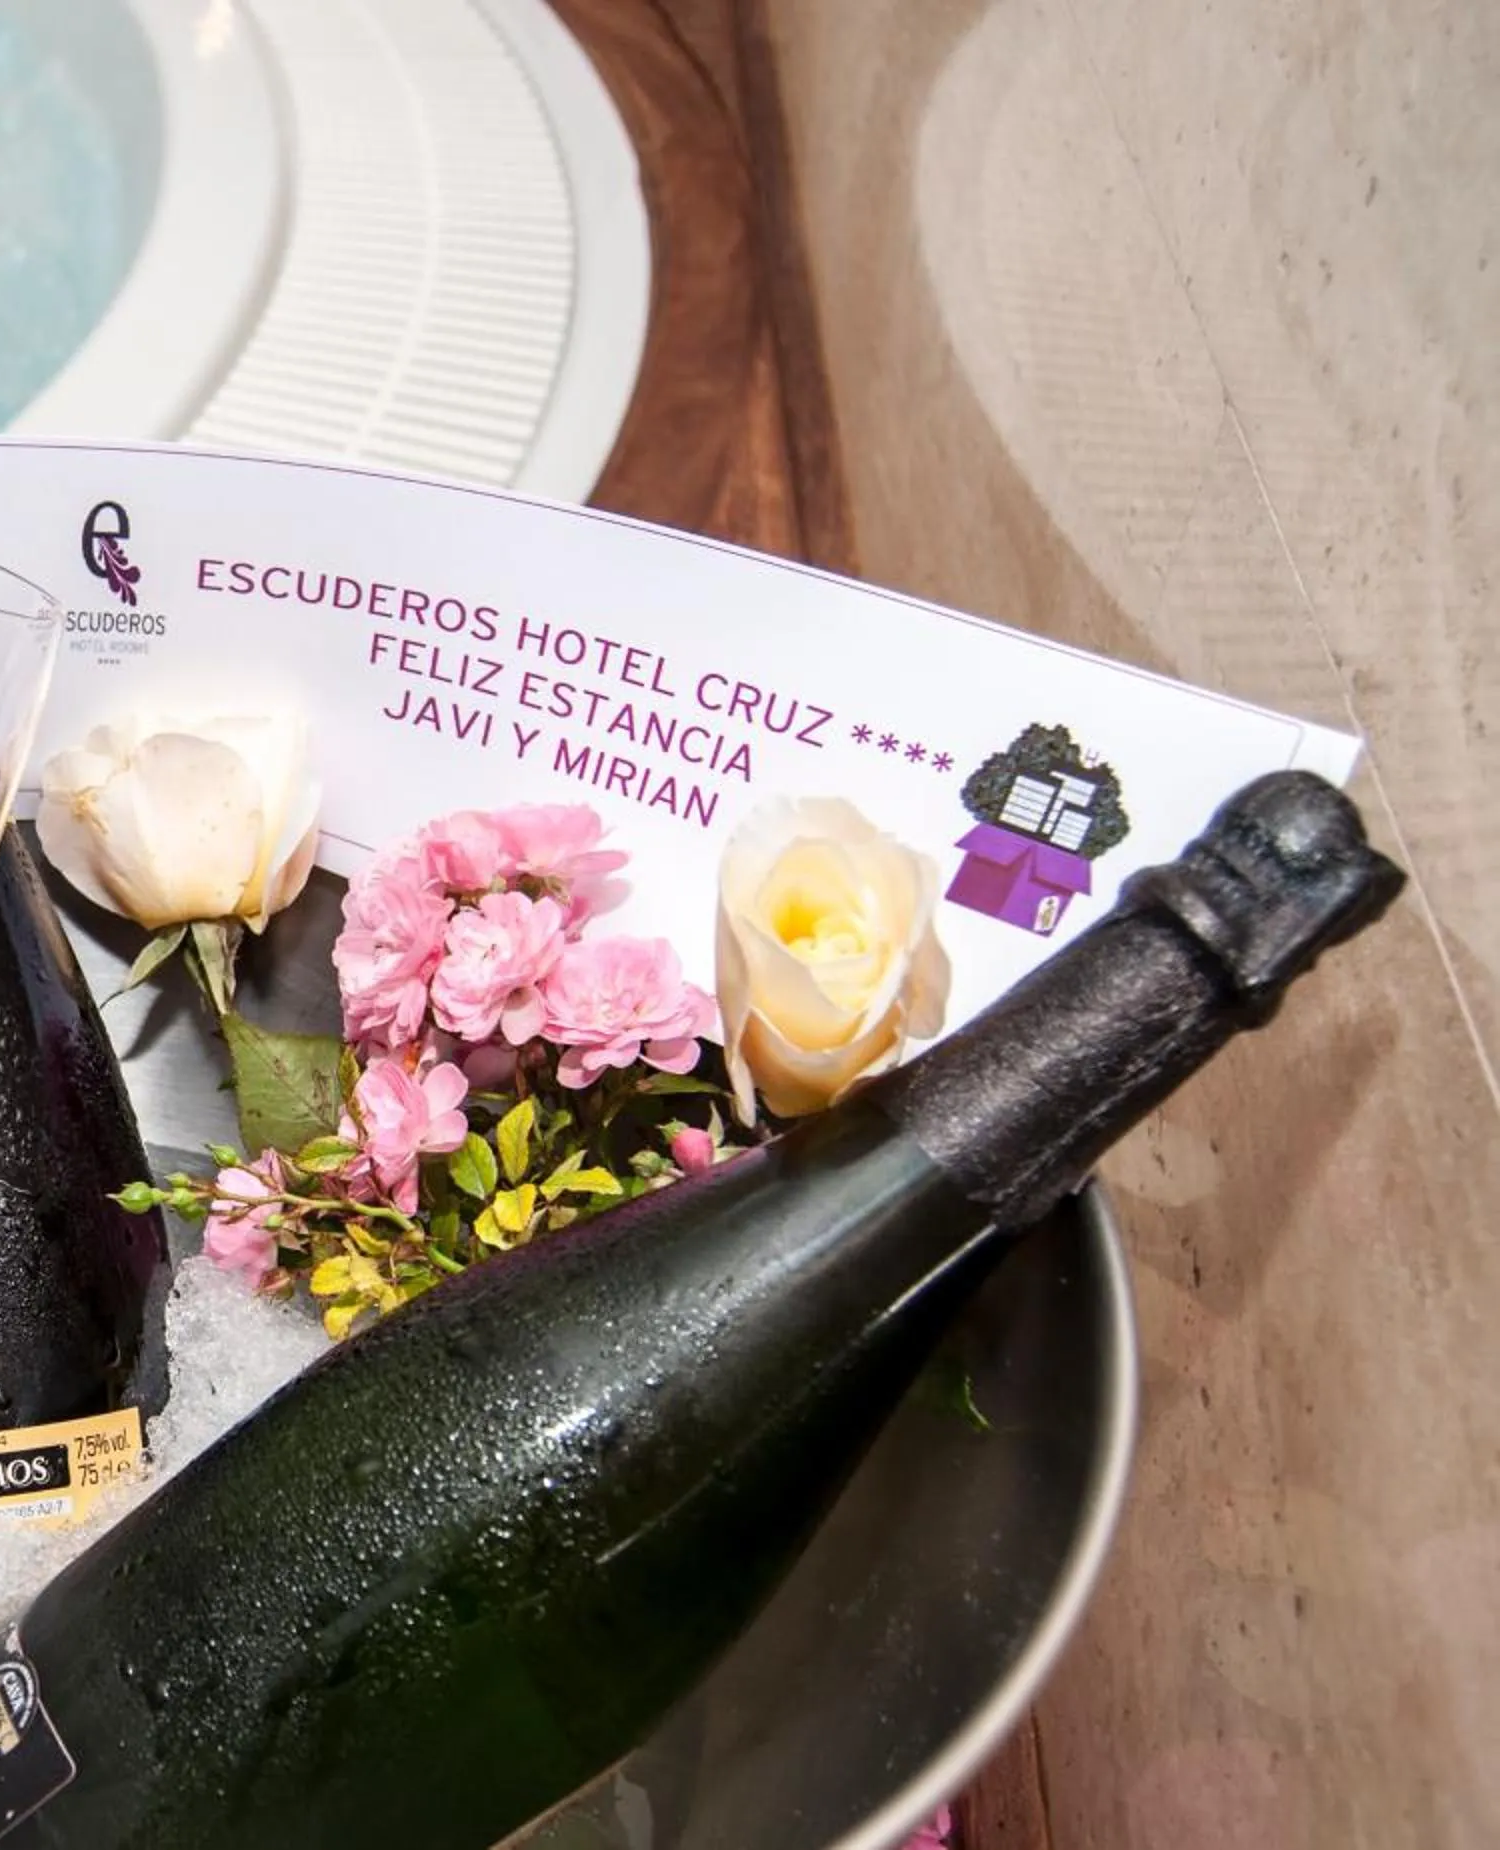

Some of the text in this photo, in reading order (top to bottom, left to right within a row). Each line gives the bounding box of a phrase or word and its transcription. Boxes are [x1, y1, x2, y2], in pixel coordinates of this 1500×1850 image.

[197, 558, 500, 642] ESCUDEROS
[516, 617, 675, 697] HOTEL
[696, 673, 834, 748] CRUZ
[369, 632, 751, 783] FELIZ ESTANCIA
[383, 689, 719, 828] JAVI Y MIRIAN
[77, 1462, 99, 1487] 75
